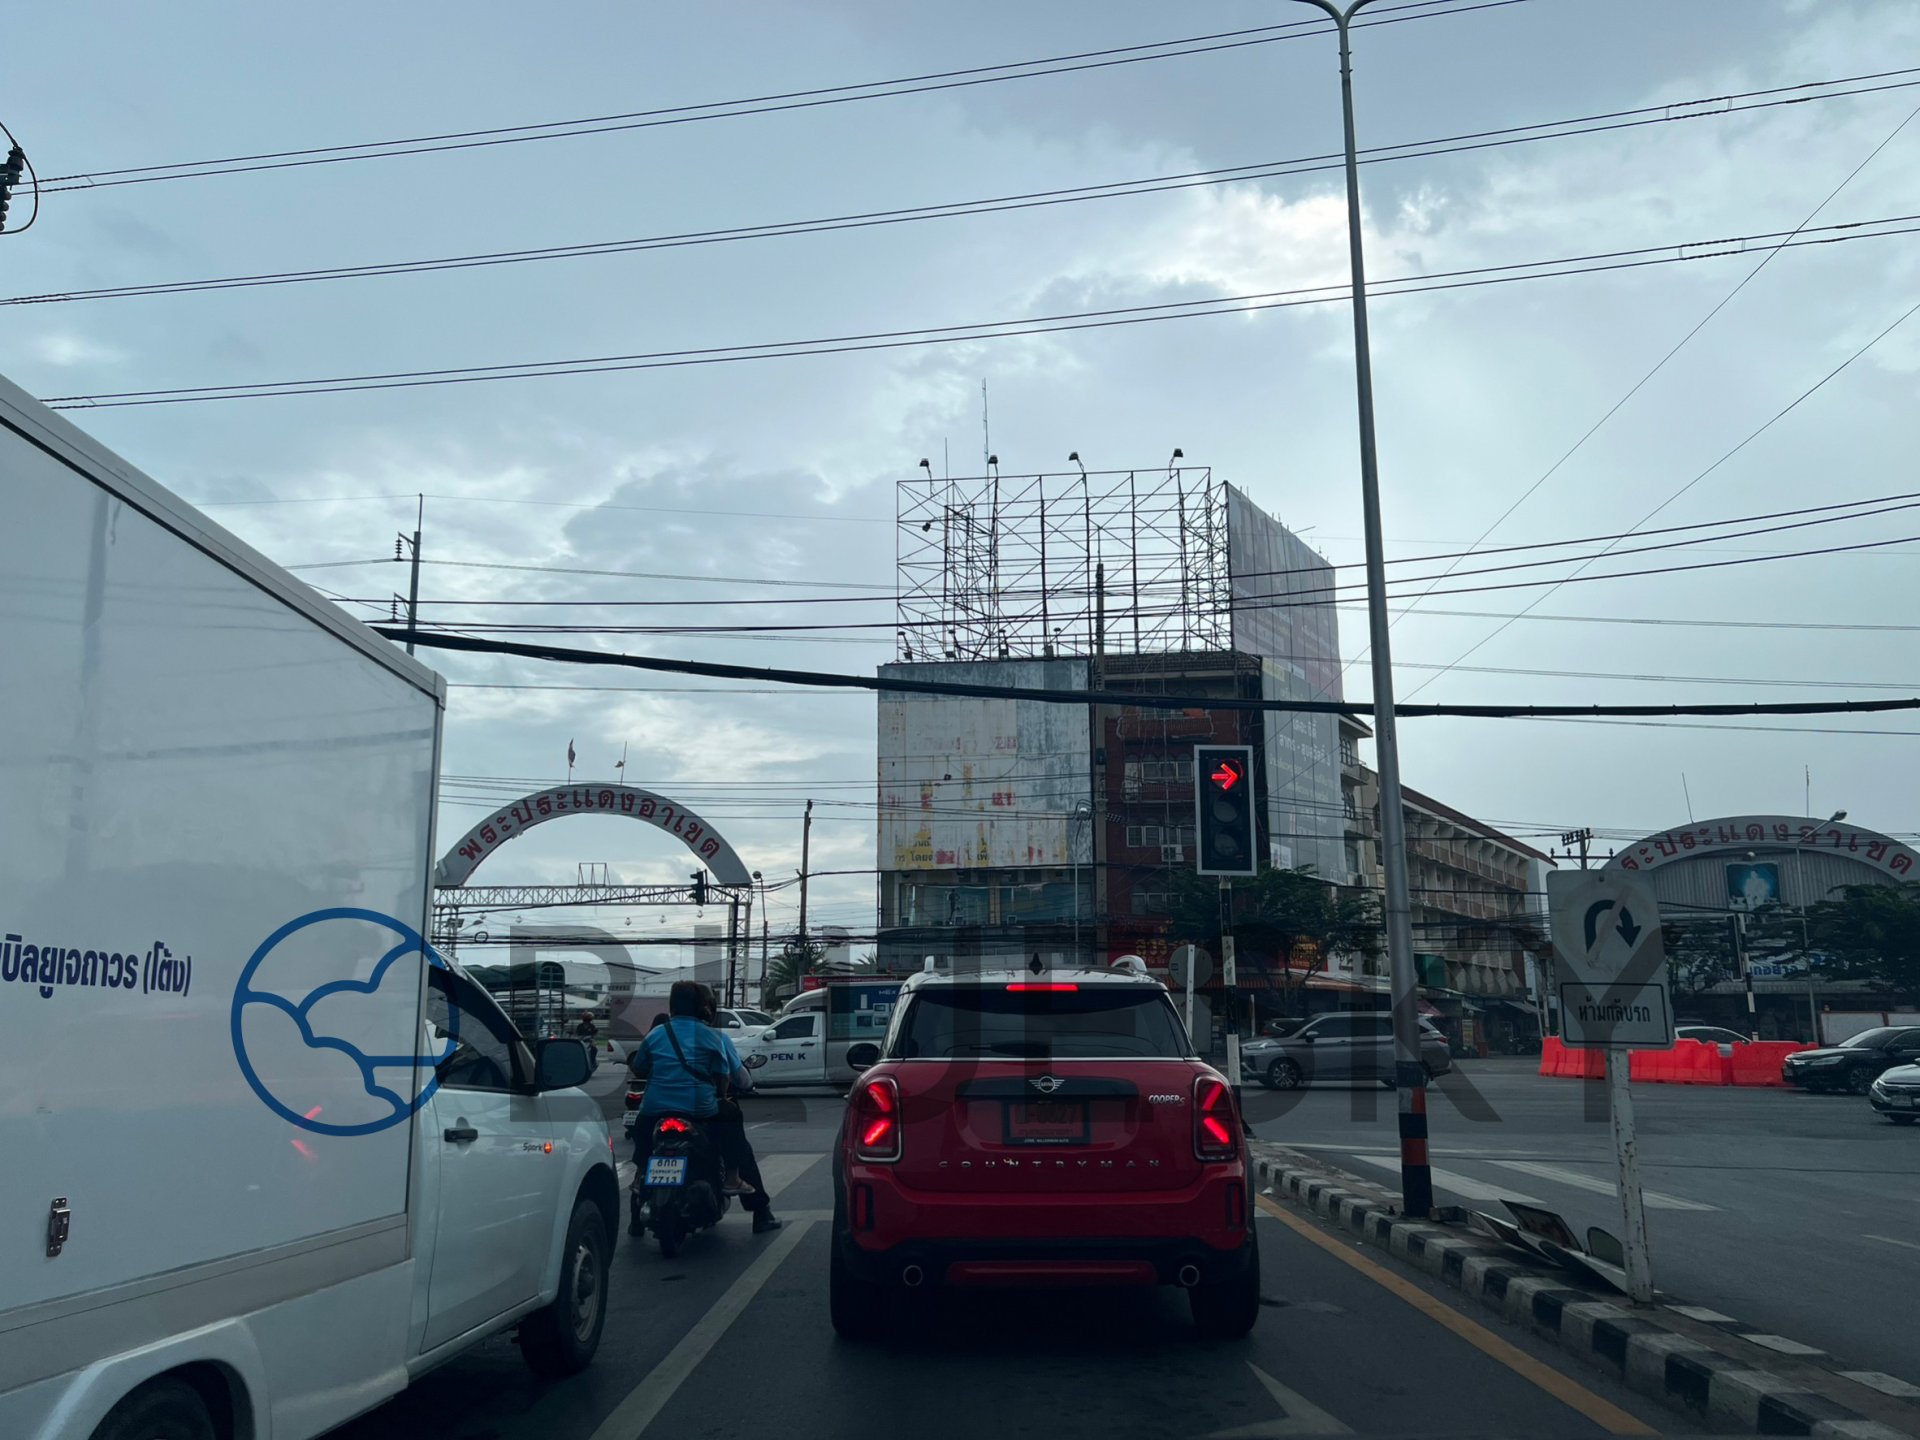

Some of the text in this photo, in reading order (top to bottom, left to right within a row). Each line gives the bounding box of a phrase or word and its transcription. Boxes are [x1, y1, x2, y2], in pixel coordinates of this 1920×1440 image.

[1621, 823, 1913, 875] ระประแดงอาเขต
[0, 933, 139, 1000] บิลยูเจถาวร
[1578, 995, 1651, 1022] ห้ามกลับรถ
[770, 1052, 806, 1061] PEN K
[1148, 1094, 1180, 1105] COOPER
[522, 1142, 544, 1152] Spark
[938, 1160, 1160, 1168] COUNTRYMAN
